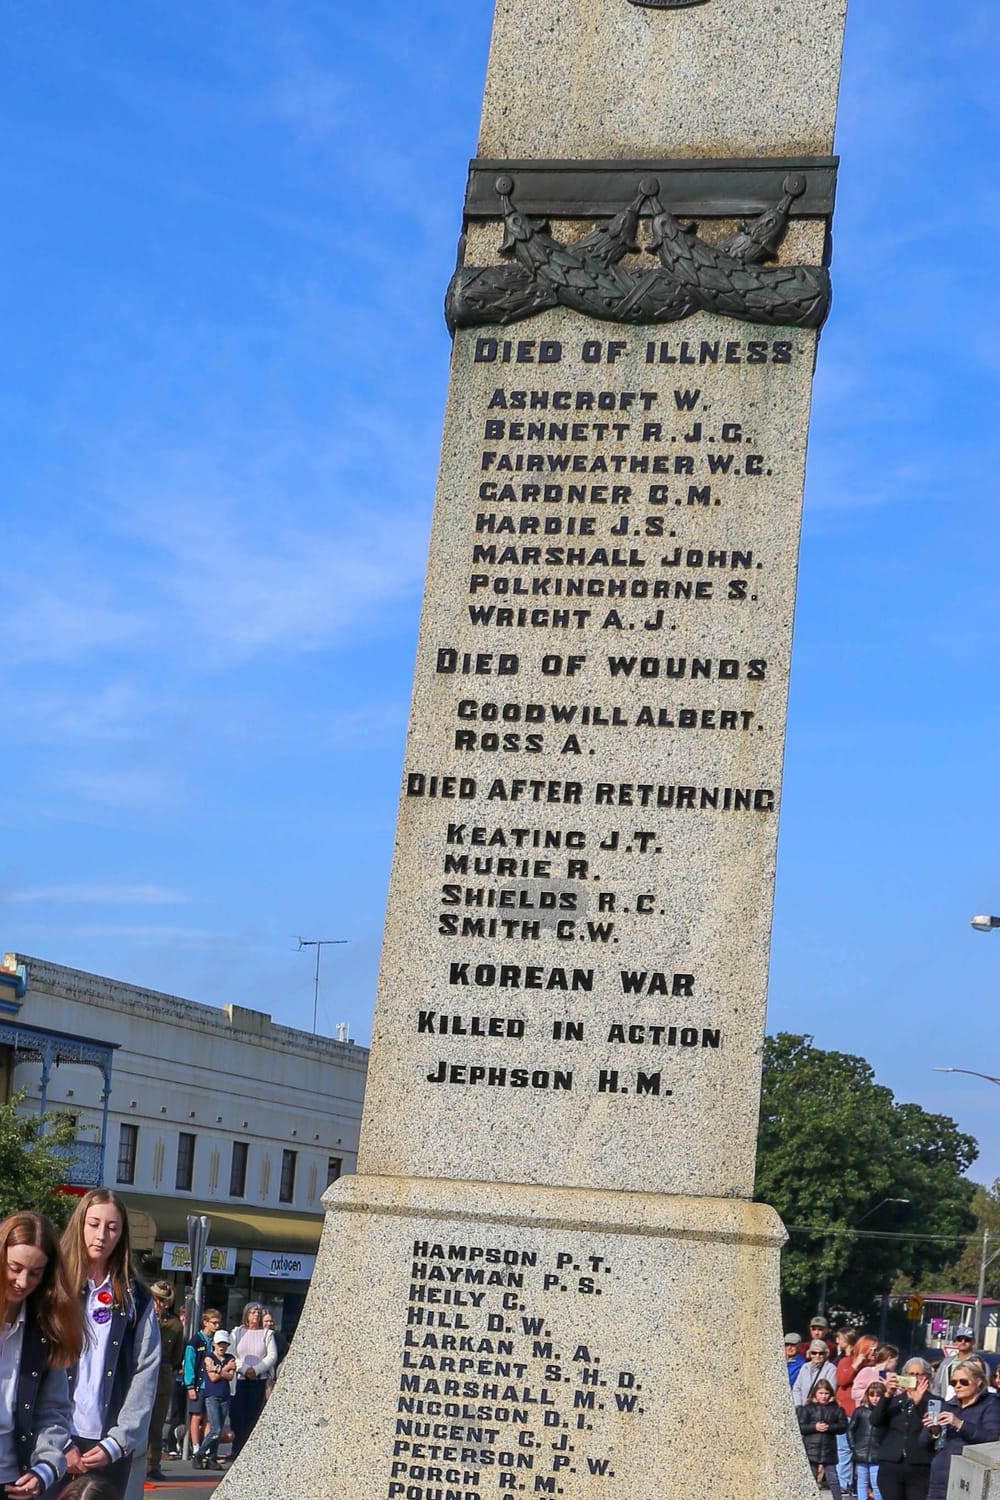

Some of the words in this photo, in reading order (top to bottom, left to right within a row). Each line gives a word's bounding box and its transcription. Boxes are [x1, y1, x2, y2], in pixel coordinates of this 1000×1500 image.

[474, 338, 562, 364] DIED
[582, 341, 628, 363] OF
[646, 341, 794, 364] ILLNESS
[487, 388, 658, 410] ASHCROFT
[673, 390, 709, 412] W.
[483, 419, 632, 441] BENNETT
[481, 451, 695, 473] FAIRWEATHER
[478, 482, 632, 505] GARDNER
[475, 514, 597, 535] HARDIE
[471, 545, 646, 567] MARSHALL
[660, 547, 763, 568] JOHN.
[469, 574, 713, 598] POLKINGHORNE
[727, 581, 758, 600] S.
[468, 605, 592, 627] WRIGHT
[436, 648, 519, 675] DIED
[541, 655, 587, 677] OF
[607, 656, 769, 681] WOUNDS
[457, 699, 629, 726] GOODWILL
[634, 706, 764, 731] ALBERT.
[454, 730, 544, 752] ROSS
[560, 734, 595, 755] A.
[406, 773, 477, 799] DIED
[487, 779, 583, 804] AFTER
[595, 783, 775, 812] RETURNING
[446, 824, 586, 849] KEATING
[444, 855, 552, 878] MURIE
[567, 859, 600, 881] R.
[441, 884, 578, 910] SHIELDS
[438, 914, 540, 940] SMITH
[449, 963, 594, 991] KOREAN
[621, 971, 696, 996] WAR
[417, 1011, 525, 1039] KILLED
[552, 1021, 584, 1041] IN
[607, 1024, 721, 1048] ACTION
[426, 1062, 573, 1090] JEPHSON
[413, 1241, 537, 1267] HAMPSON
[411, 1263, 524, 1287] HAYMAN
[408, 1284, 486, 1307] HEILY
[407, 1307, 469, 1329] HILL
[404, 1330, 513, 1355] LARKAN
[402, 1352, 528, 1378] LARPENT
[400, 1374, 555, 1405] MARSHALL
[397, 1397, 529, 1423] NICOLSON
[393, 1441, 534, 1469] PETERSON
[390, 1462, 480, 1486] PORCH
